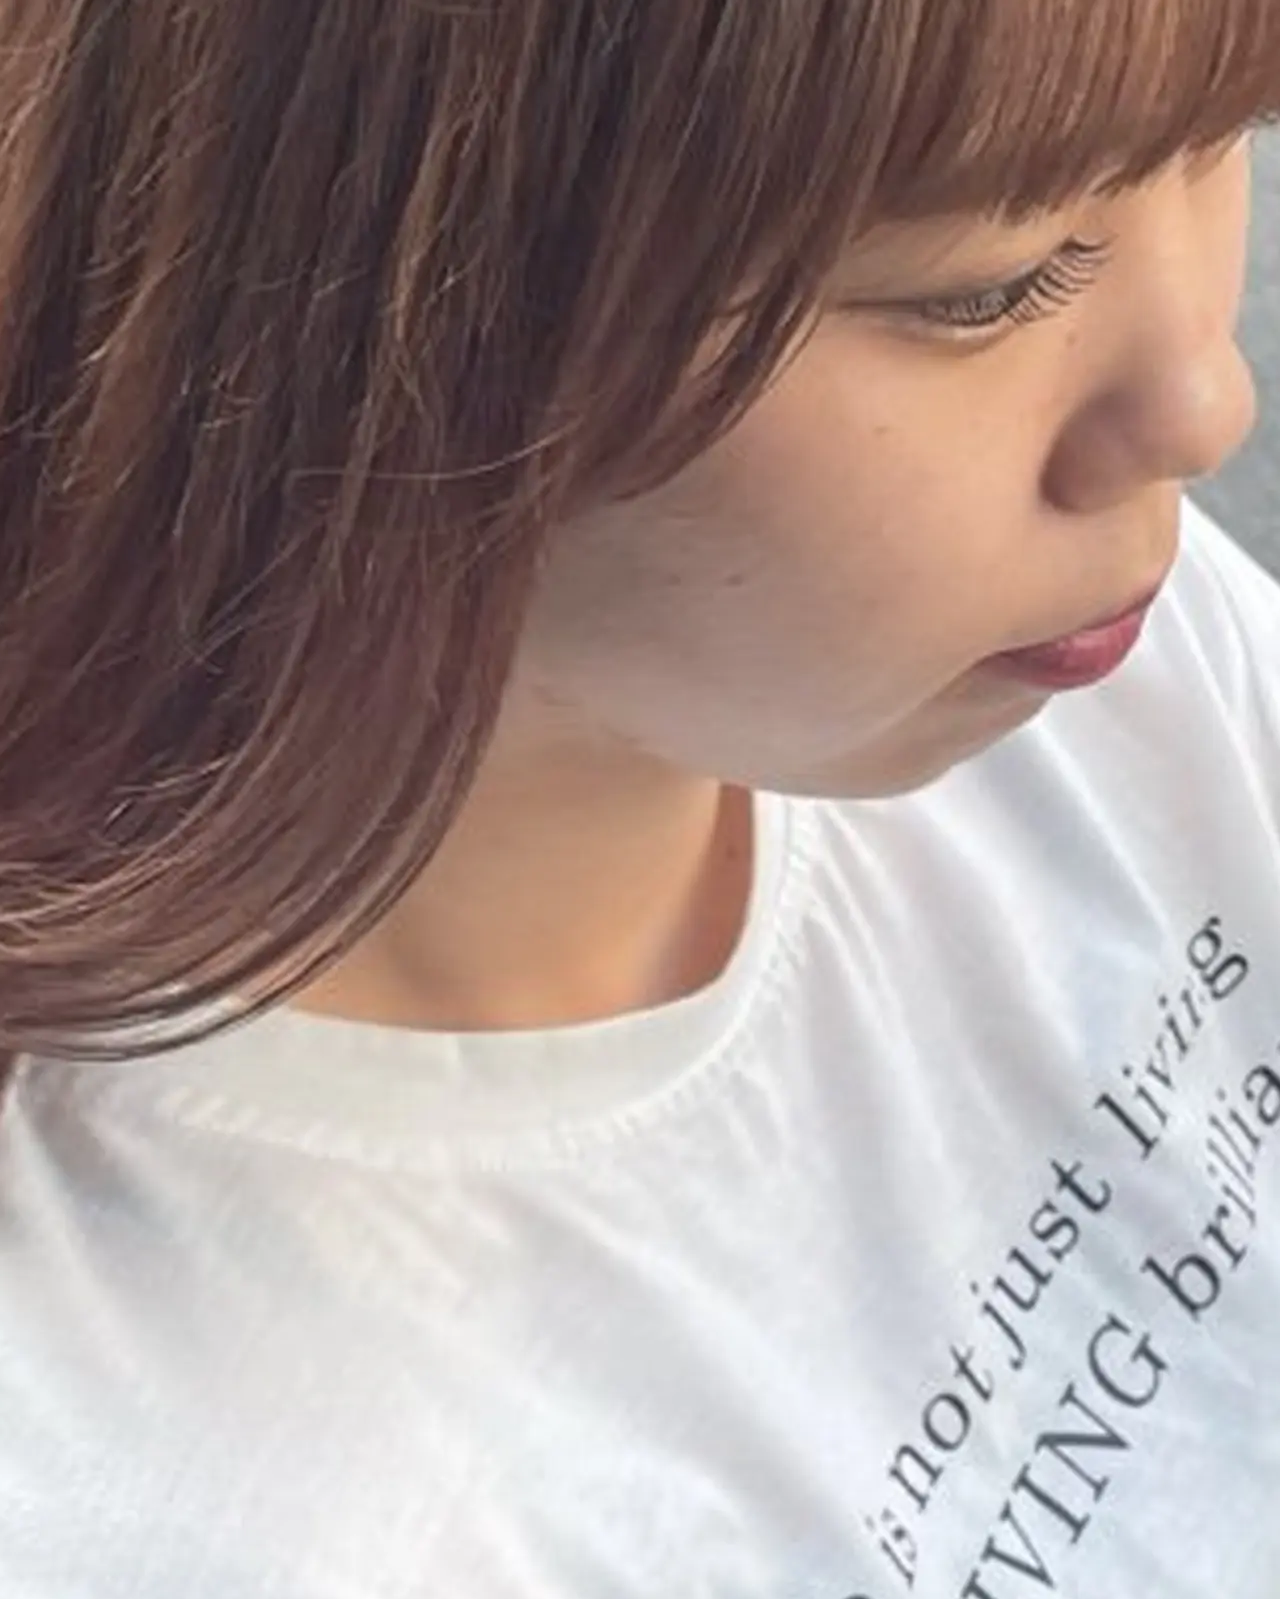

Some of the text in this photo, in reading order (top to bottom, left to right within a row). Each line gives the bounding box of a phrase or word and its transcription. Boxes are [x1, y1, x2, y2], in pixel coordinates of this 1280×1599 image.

[970, 1158, 1113, 1371] just
[887, 1345, 995, 1513] not
[865, 1508, 919, 1589] is
